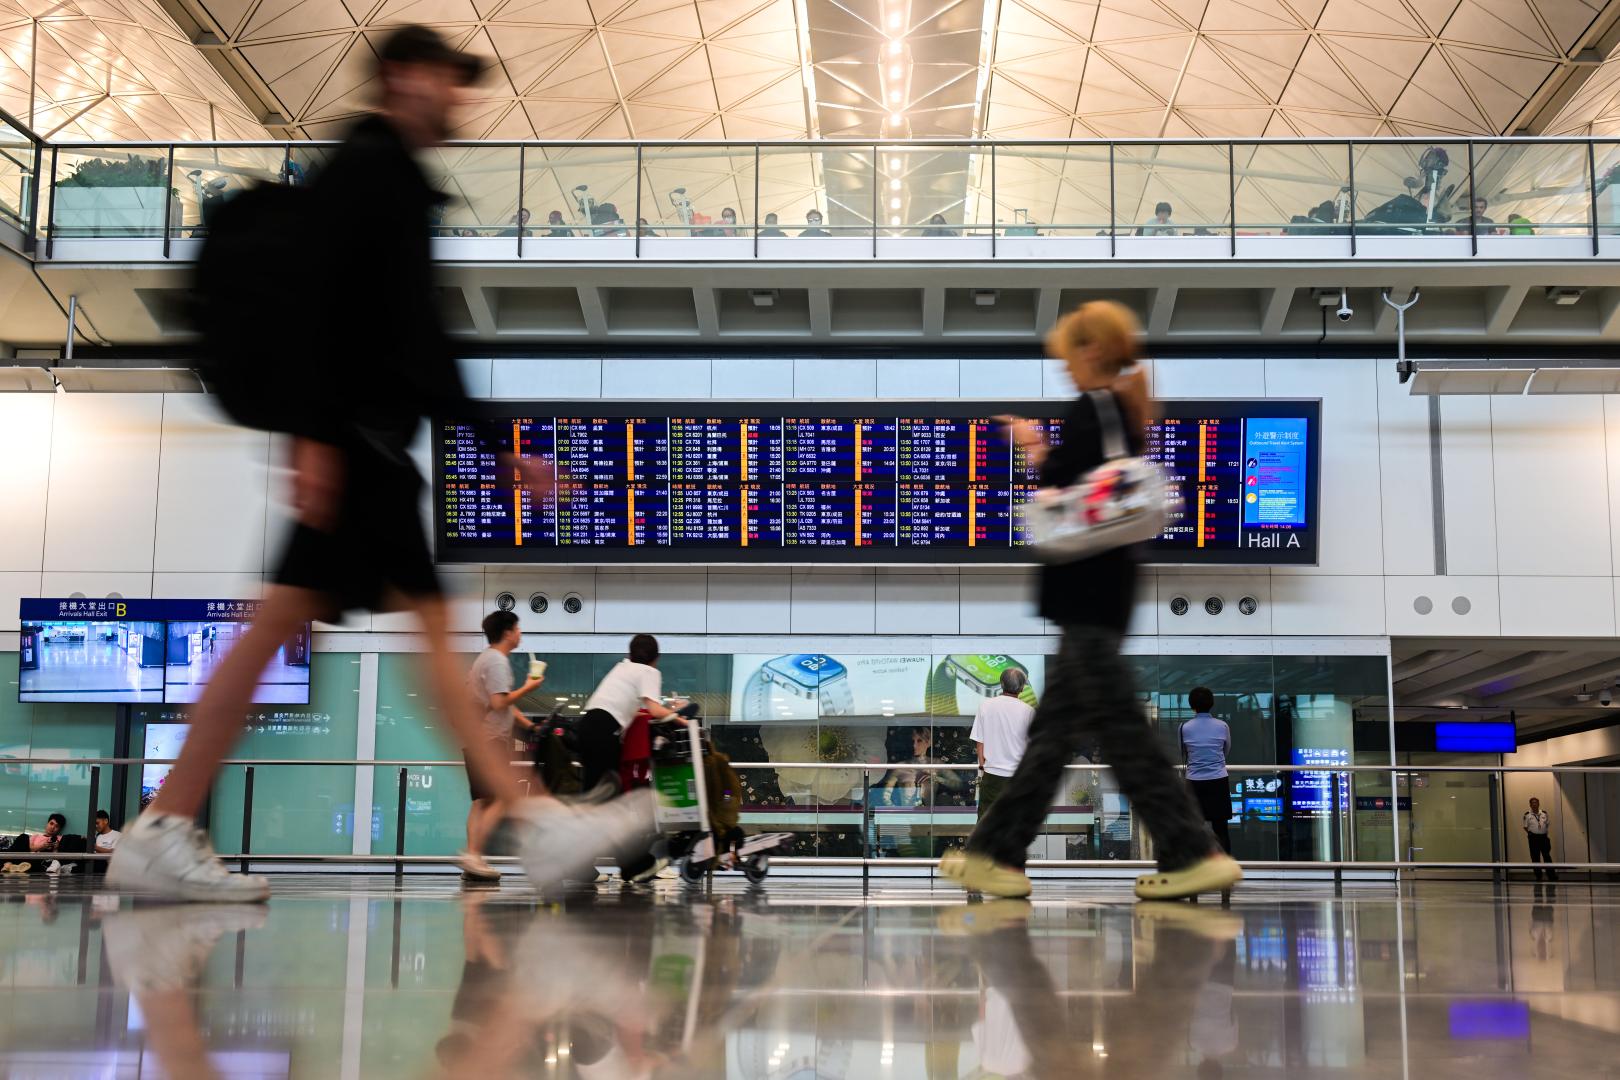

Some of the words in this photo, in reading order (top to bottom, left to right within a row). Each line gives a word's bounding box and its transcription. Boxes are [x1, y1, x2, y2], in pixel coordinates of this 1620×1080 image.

[1249, 533, 1279, 548] Hall
[1286, 533, 1300, 548] A
[59, 602, 115, 610] 接機大堂出口
[116, 603, 126, 616] B
